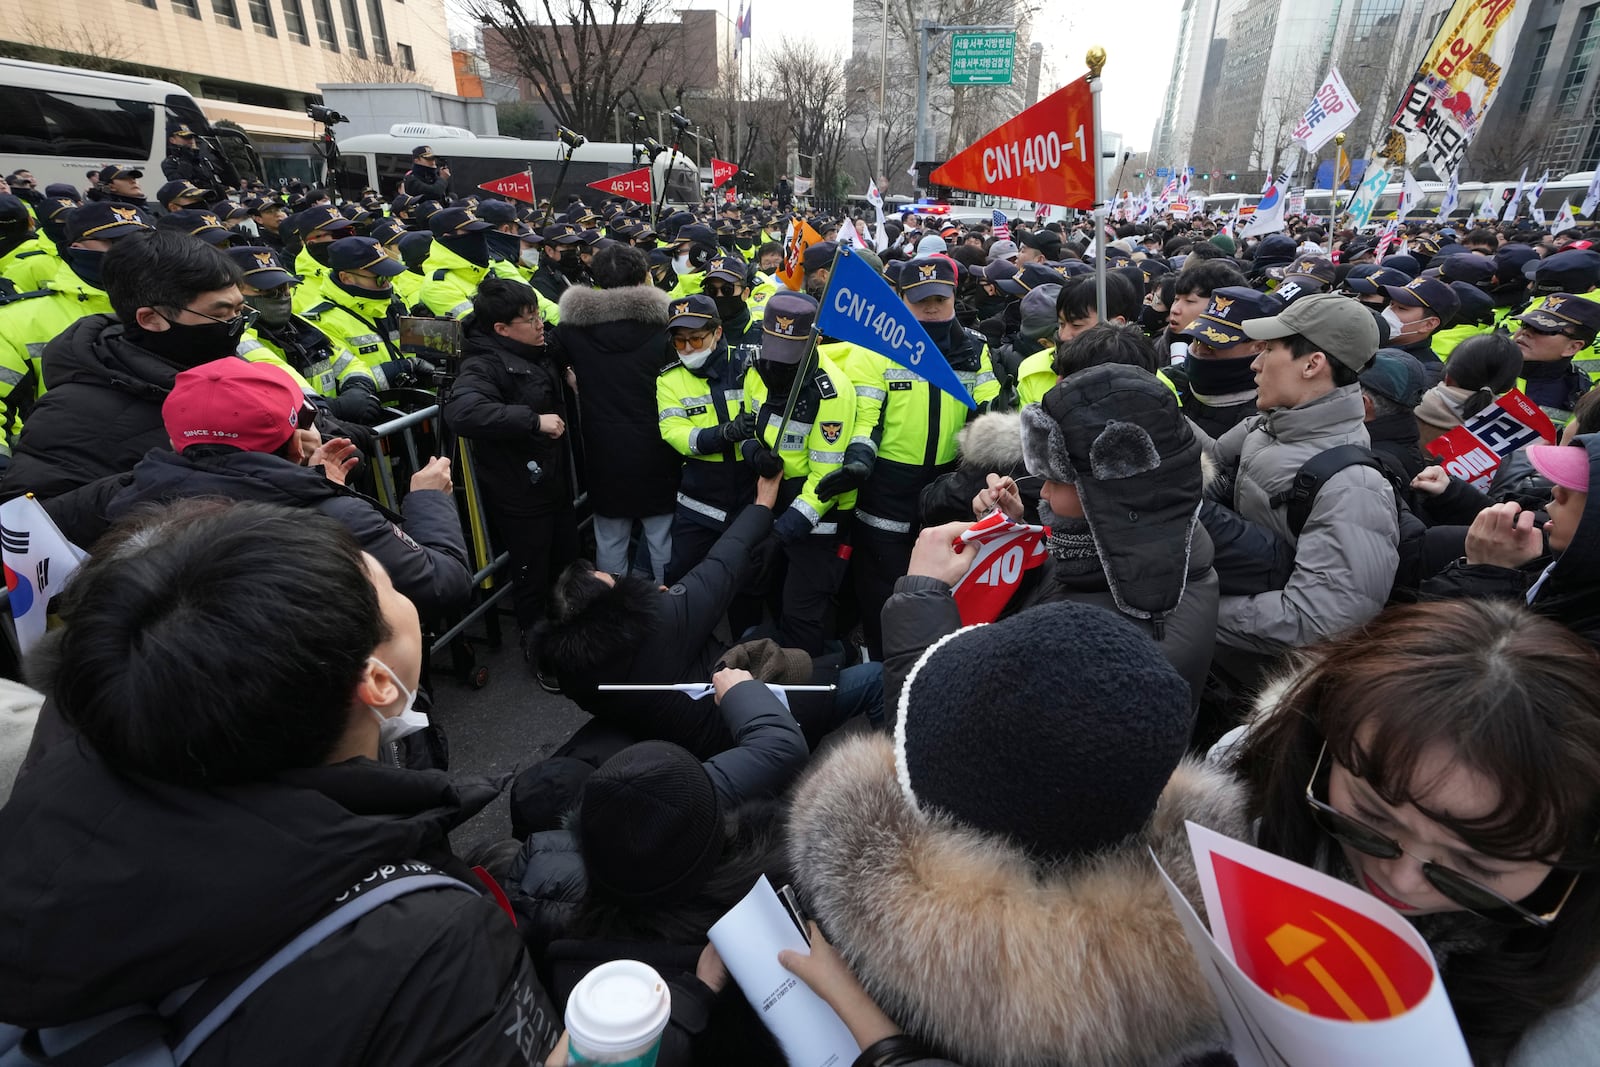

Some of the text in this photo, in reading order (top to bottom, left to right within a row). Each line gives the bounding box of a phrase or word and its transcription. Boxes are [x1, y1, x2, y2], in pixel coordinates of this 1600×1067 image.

[1305, 98, 1327, 129] THE
[1317, 84, 1344, 115] STOP
[982, 124, 1087, 184] CN1400-1
[497, 182, 530, 193] 41기-1
[611, 180, 650, 193] 46기-3
[834, 287, 926, 366] CN1400-3
[183, 429, 209, 437] SINCE
